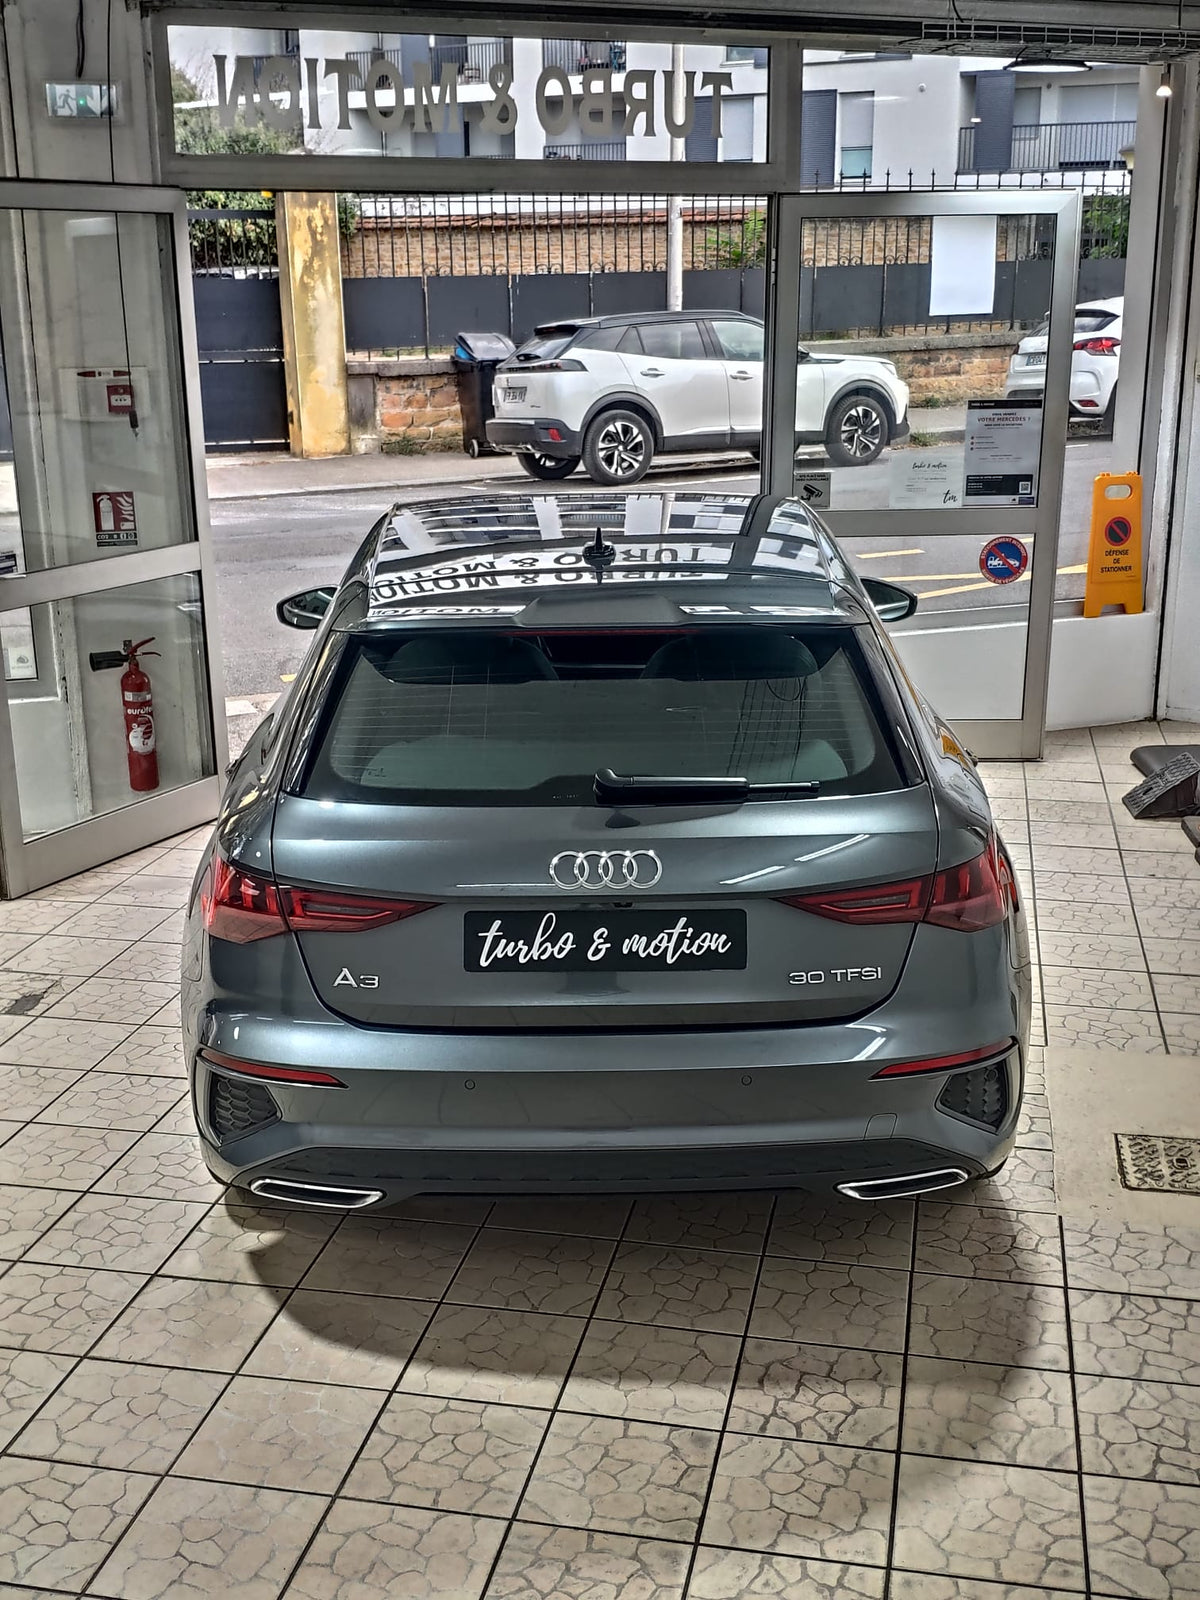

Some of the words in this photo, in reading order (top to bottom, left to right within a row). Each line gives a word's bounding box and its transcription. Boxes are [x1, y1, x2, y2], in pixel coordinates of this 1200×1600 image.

[554, 548, 705, 566] TURO
[478, 912, 577, 967] turbo
[587, 927, 611, 962] &
[622, 917, 732, 965] motion
[332, 967, 379, 988] A3
[789, 970, 825, 985] 30
[830, 966, 882, 982] TFSI
